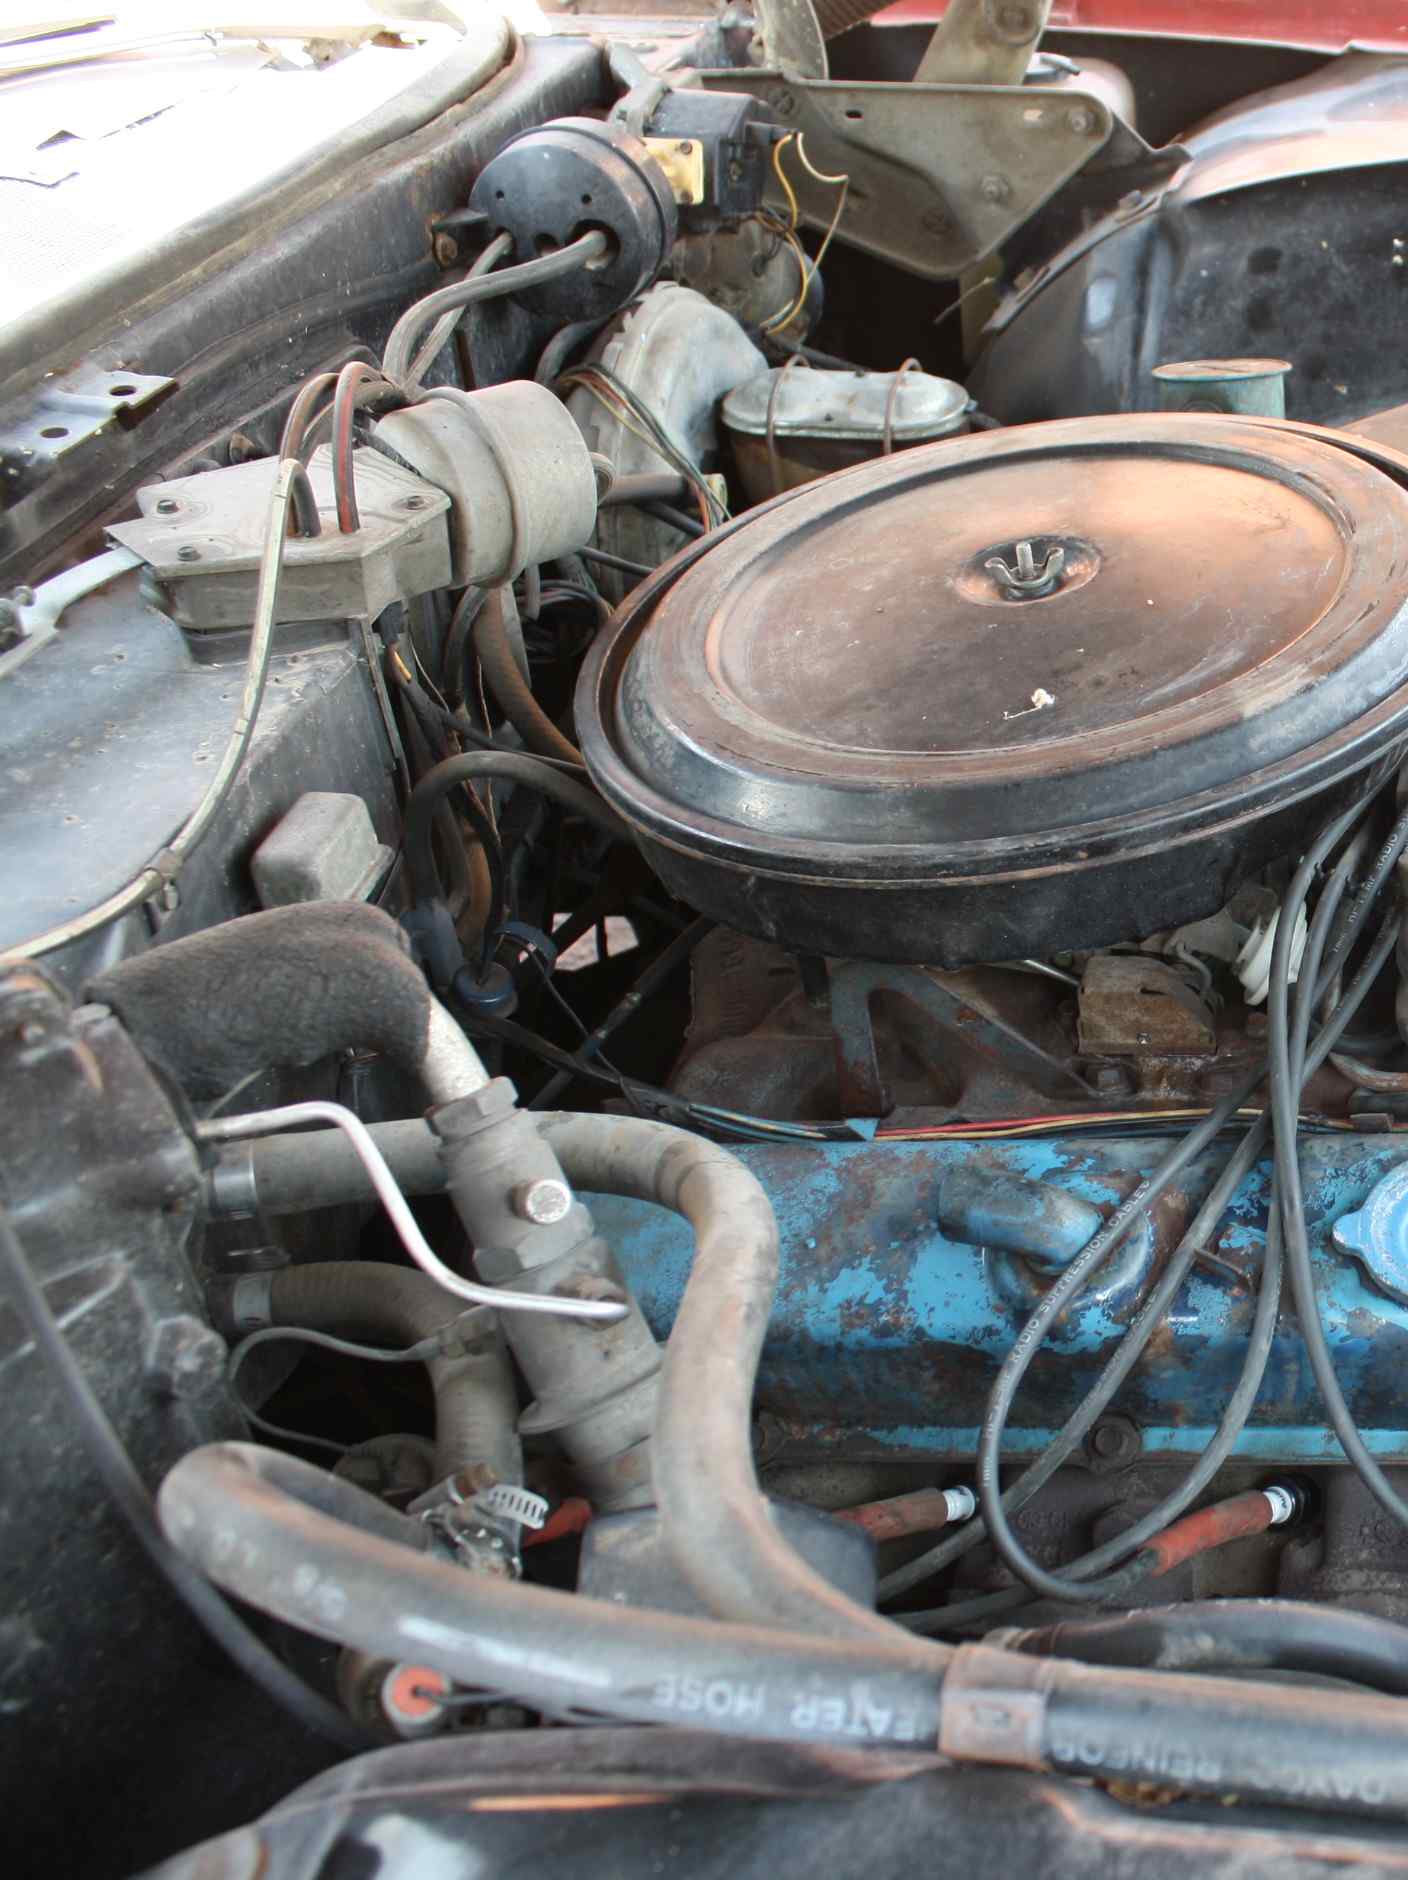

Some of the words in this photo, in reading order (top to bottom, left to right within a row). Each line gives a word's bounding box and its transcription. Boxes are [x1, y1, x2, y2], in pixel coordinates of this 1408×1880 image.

[1375, 832, 1400, 870] RADIO
[1011, 1318, 1039, 1362] RADIO
[1038, 1230, 1108, 1313] SUPPRESSION
[654, 1675, 766, 1717] HOSE
